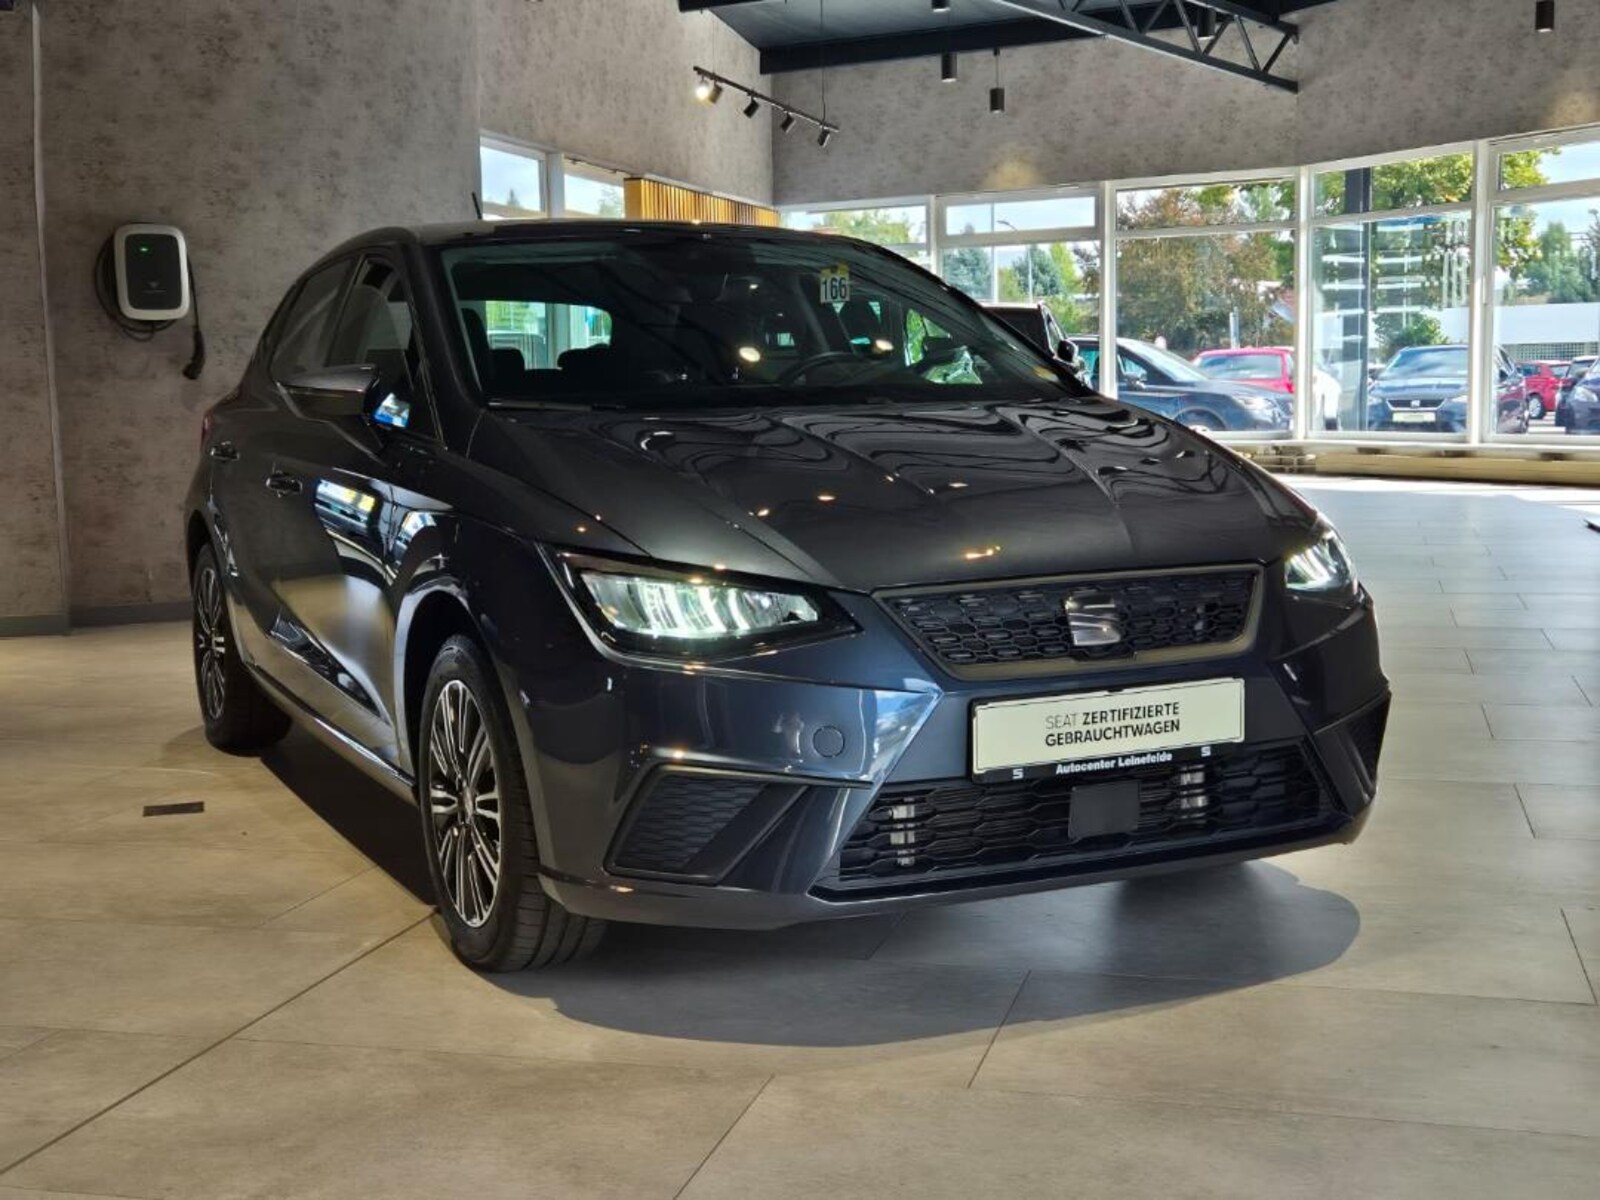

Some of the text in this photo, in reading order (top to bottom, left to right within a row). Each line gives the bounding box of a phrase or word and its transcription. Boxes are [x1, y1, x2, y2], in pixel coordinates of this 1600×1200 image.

[822, 277, 847, 300] 166
[1045, 702, 1180, 730] SEAT ZERTIFIZIERTE
[1045, 719, 1180, 746] GEBRAUCHTWAGEN
[1056, 751, 1173, 775] Autocenter Leinefelde
